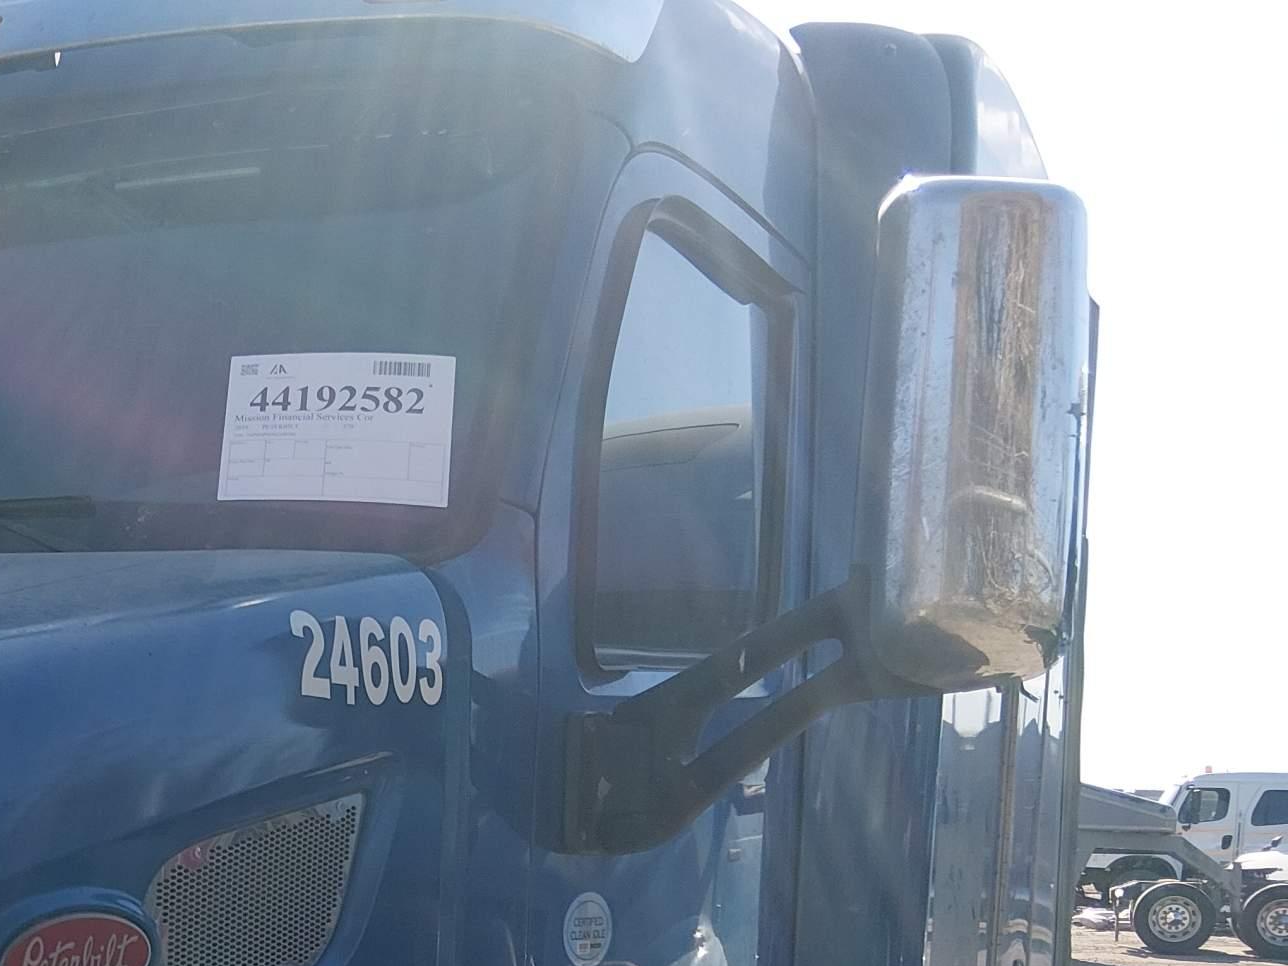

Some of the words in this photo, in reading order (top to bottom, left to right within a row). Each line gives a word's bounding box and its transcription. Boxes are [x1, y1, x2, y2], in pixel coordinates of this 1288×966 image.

[249, 385, 425, 414] 44192582
[234, 414, 270, 422] Mission
[272, 412, 314, 422] Financial
[315, 413, 355, 422] Services
[290, 609, 443, 706] 24603
